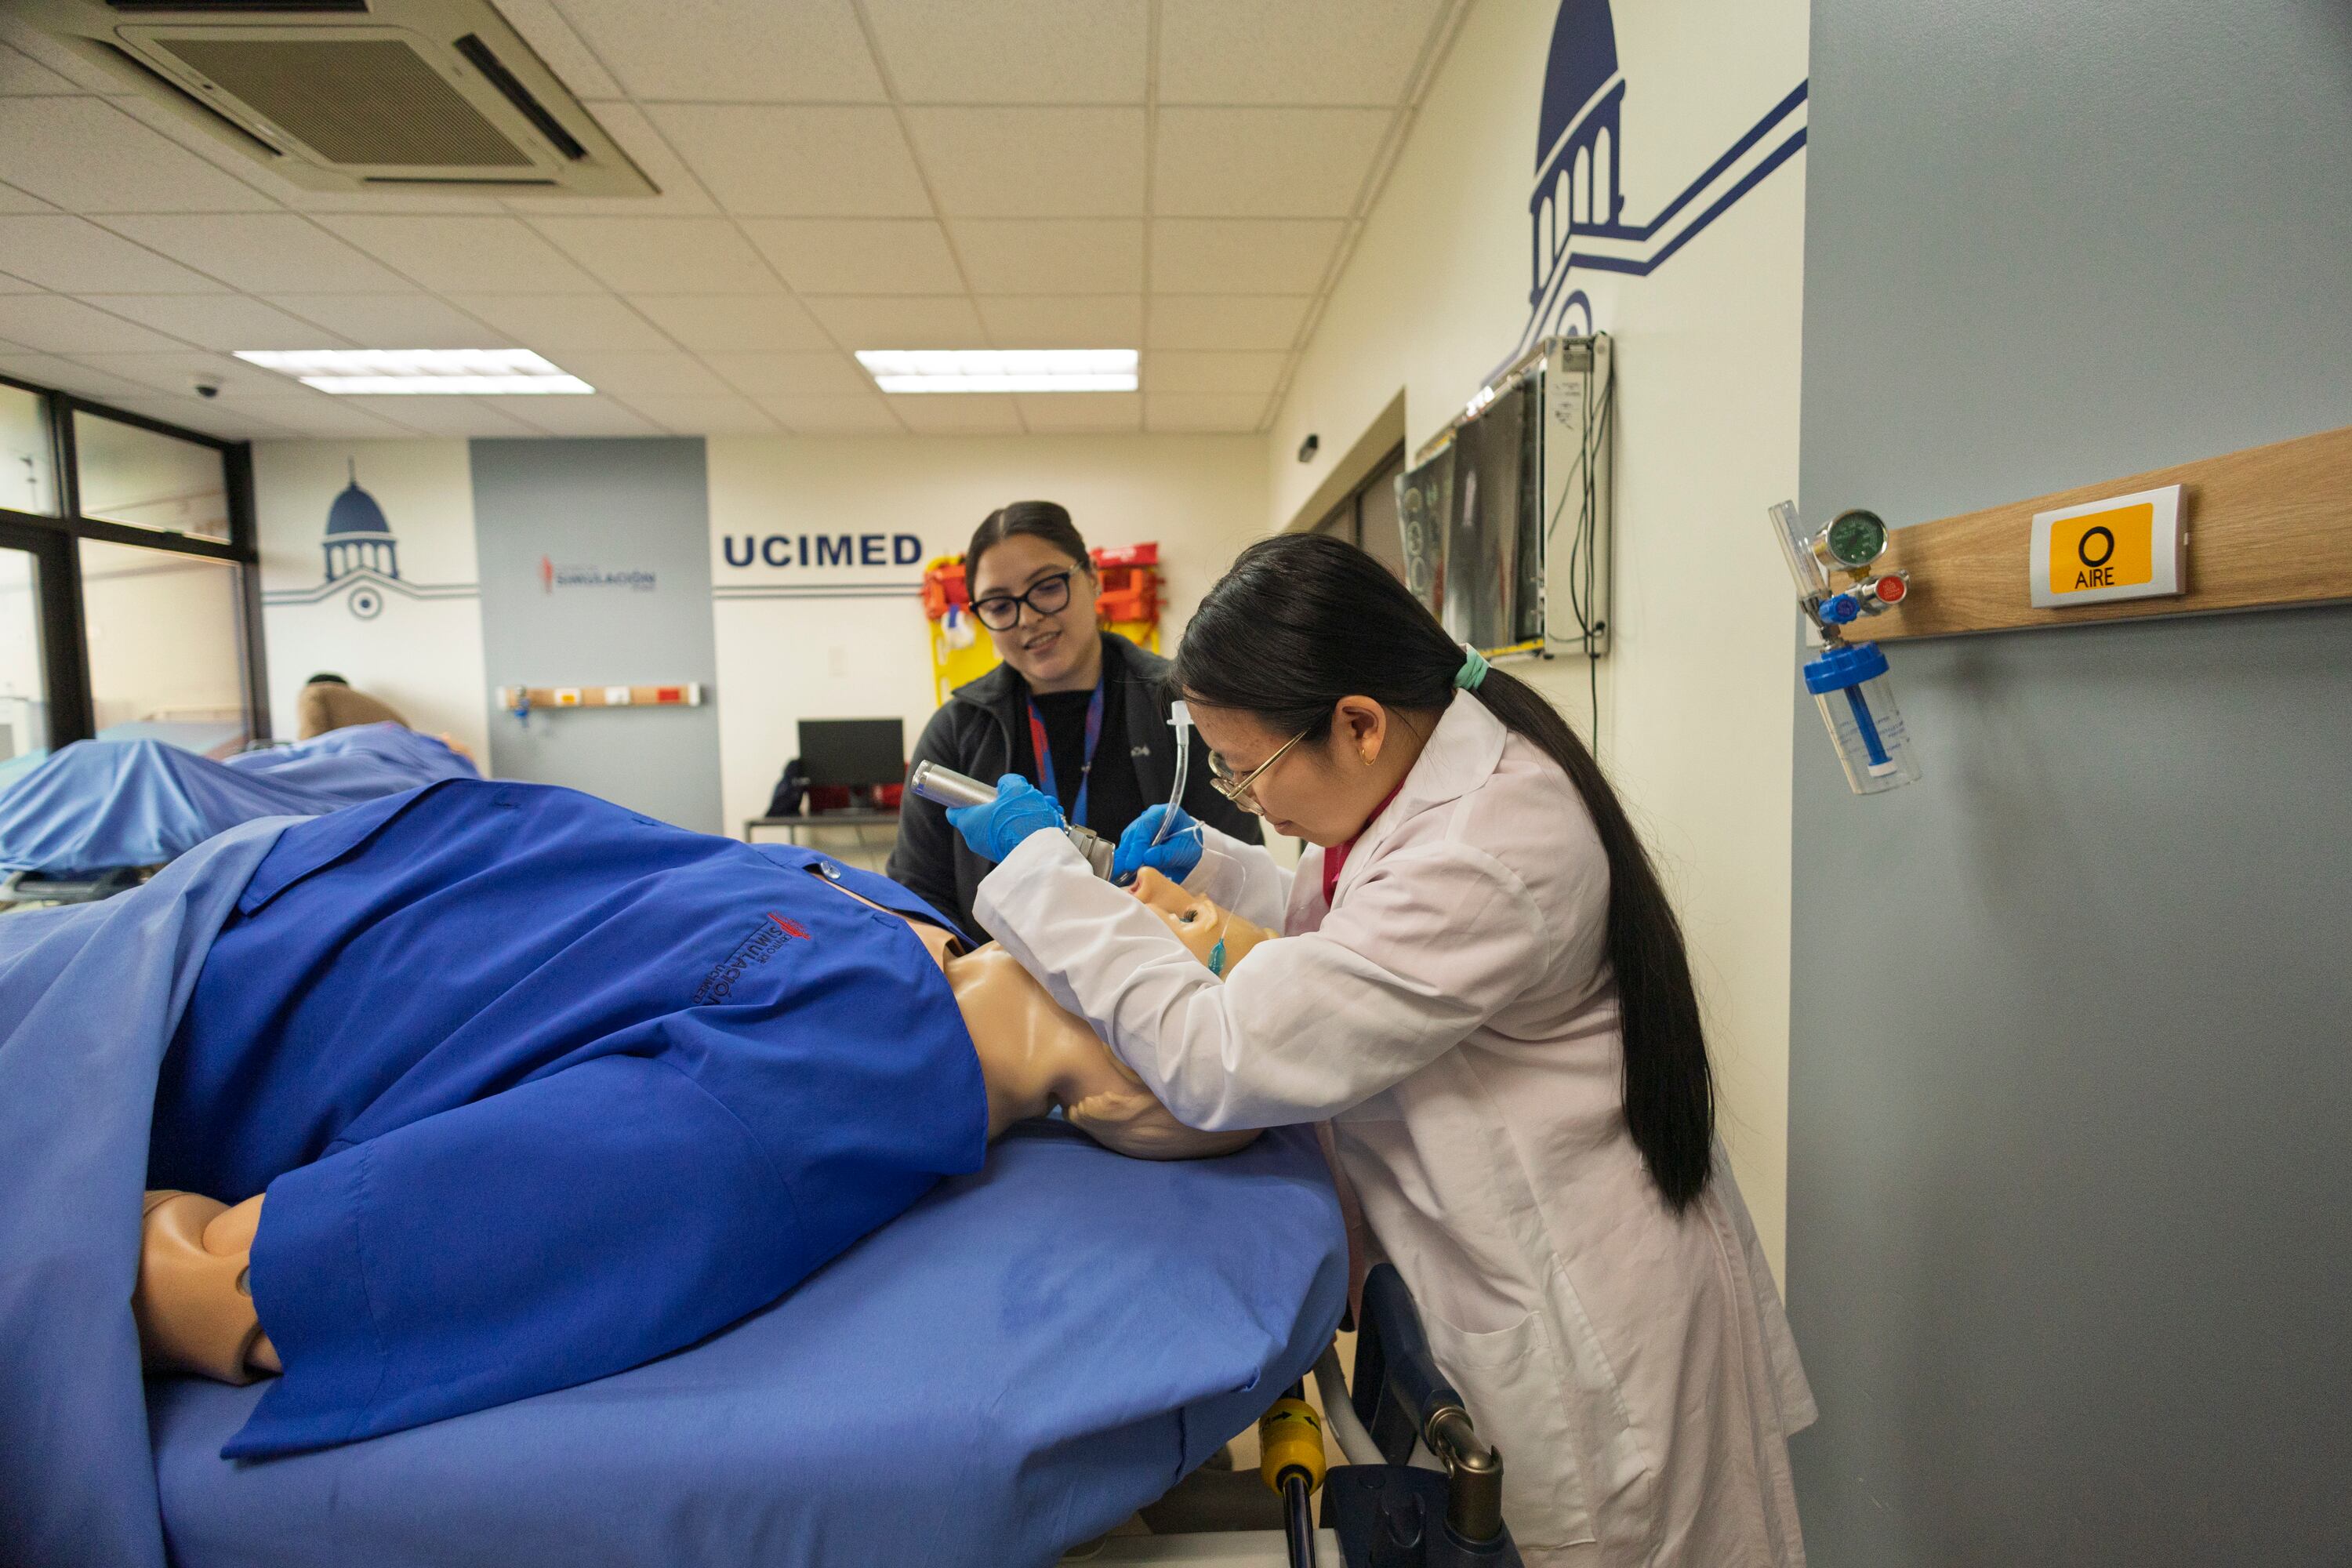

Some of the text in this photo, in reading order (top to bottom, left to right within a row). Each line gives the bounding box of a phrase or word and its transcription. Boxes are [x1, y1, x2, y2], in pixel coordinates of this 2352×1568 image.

[724, 535, 922, 567] UCIMED
[2075, 567, 2114, 589] AIRE
[693, 964, 725, 1004] UCIMED
